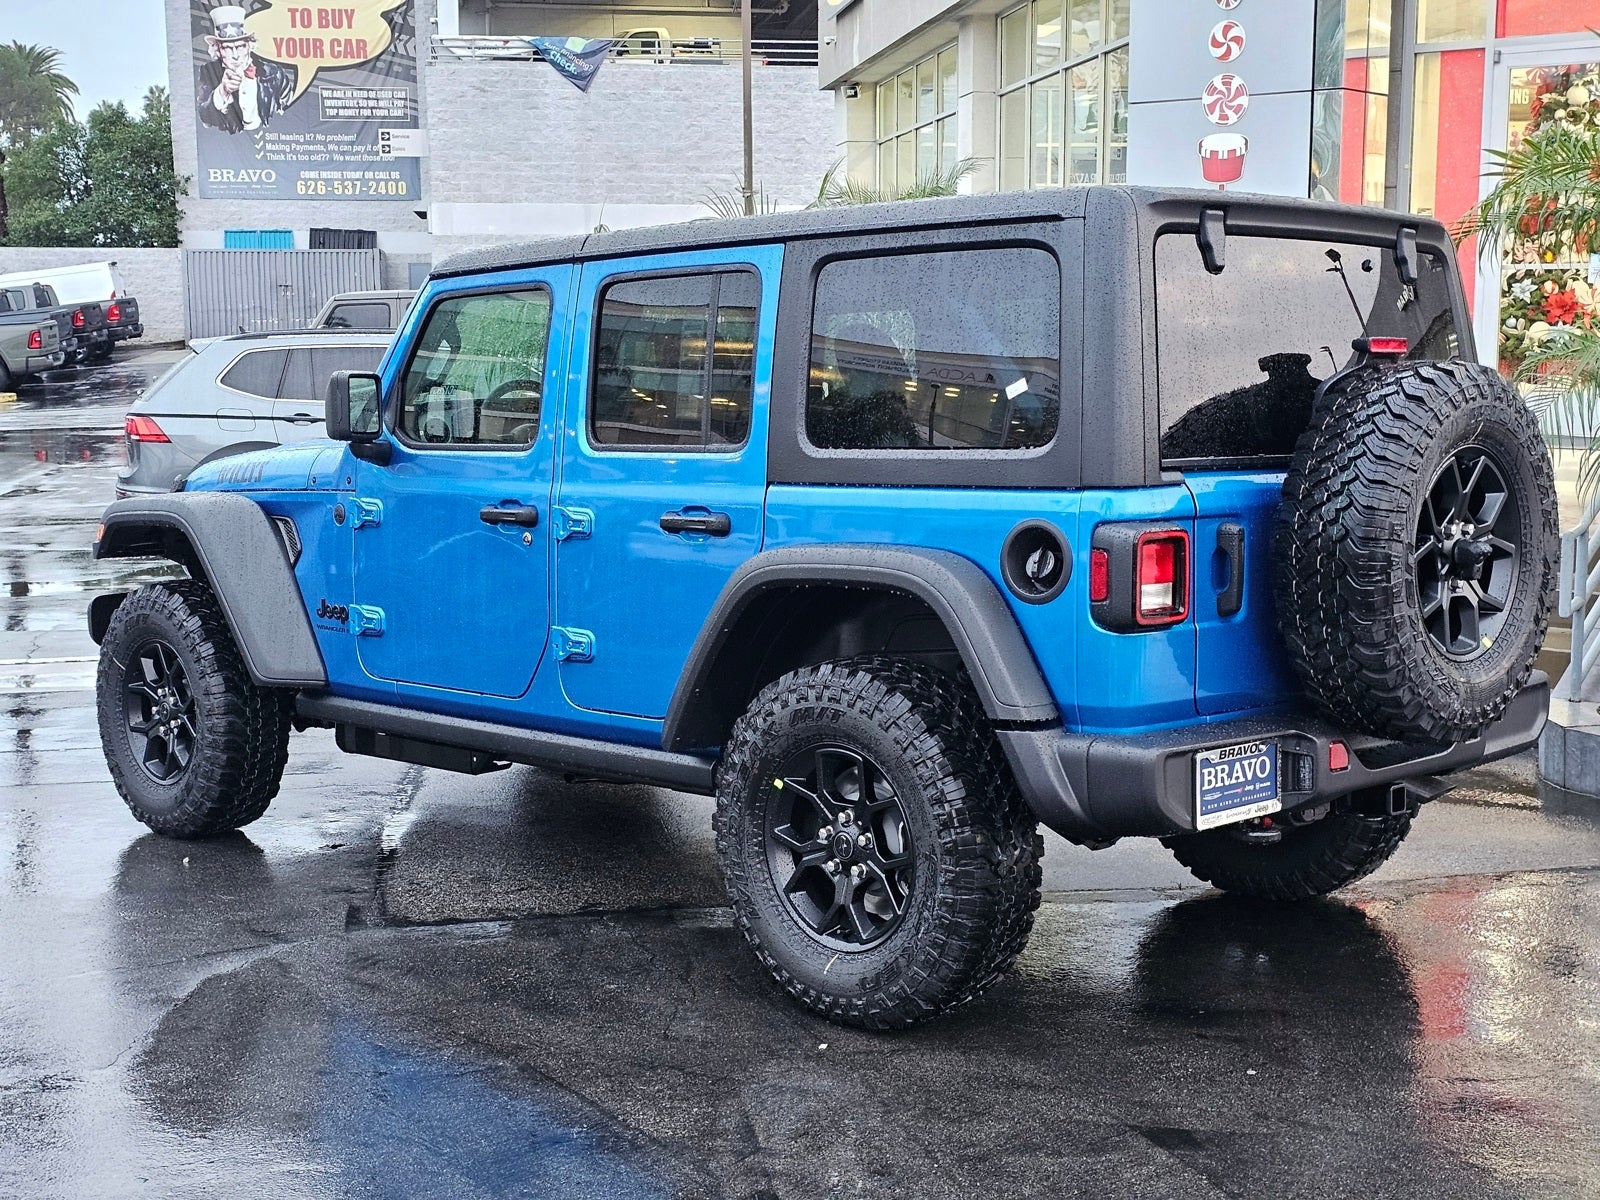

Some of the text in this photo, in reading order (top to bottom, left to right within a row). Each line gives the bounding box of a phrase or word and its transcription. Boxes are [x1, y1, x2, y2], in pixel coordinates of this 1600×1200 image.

[287, 7, 356, 30] TO BUY
[272, 37, 368, 60] YOUR CAR
[543, 41, 595, 72] Auto financing?
[549, 50, 578, 76] Check.
[322, 90, 406, 98] WE ARE IN NEED OF USED CAR
[265, 132, 278, 140] Still
[280, 133, 304, 142] leasing
[327, 134, 357, 142] problem!
[266, 143, 290, 152] Making
[292, 144, 326, 152] Payments,
[266, 153, 286, 161] Think
[286, 153, 297, 161] it's
[298, 153, 309, 161] too
[310, 153, 329, 161] old??
[362, 154, 380, 162] those
[208, 168, 276, 183] BRAVO
[300, 171, 400, 179] COME INSIDE TODAY OR CALL US
[296, 180, 407, 196] 626-537-2400
[316, 598, 349, 624] Jeep
[789, 704, 845, 725] M/T
[1218, 743, 1258, 760] BRAVO
[1202, 756, 1271, 790] BRAVO
